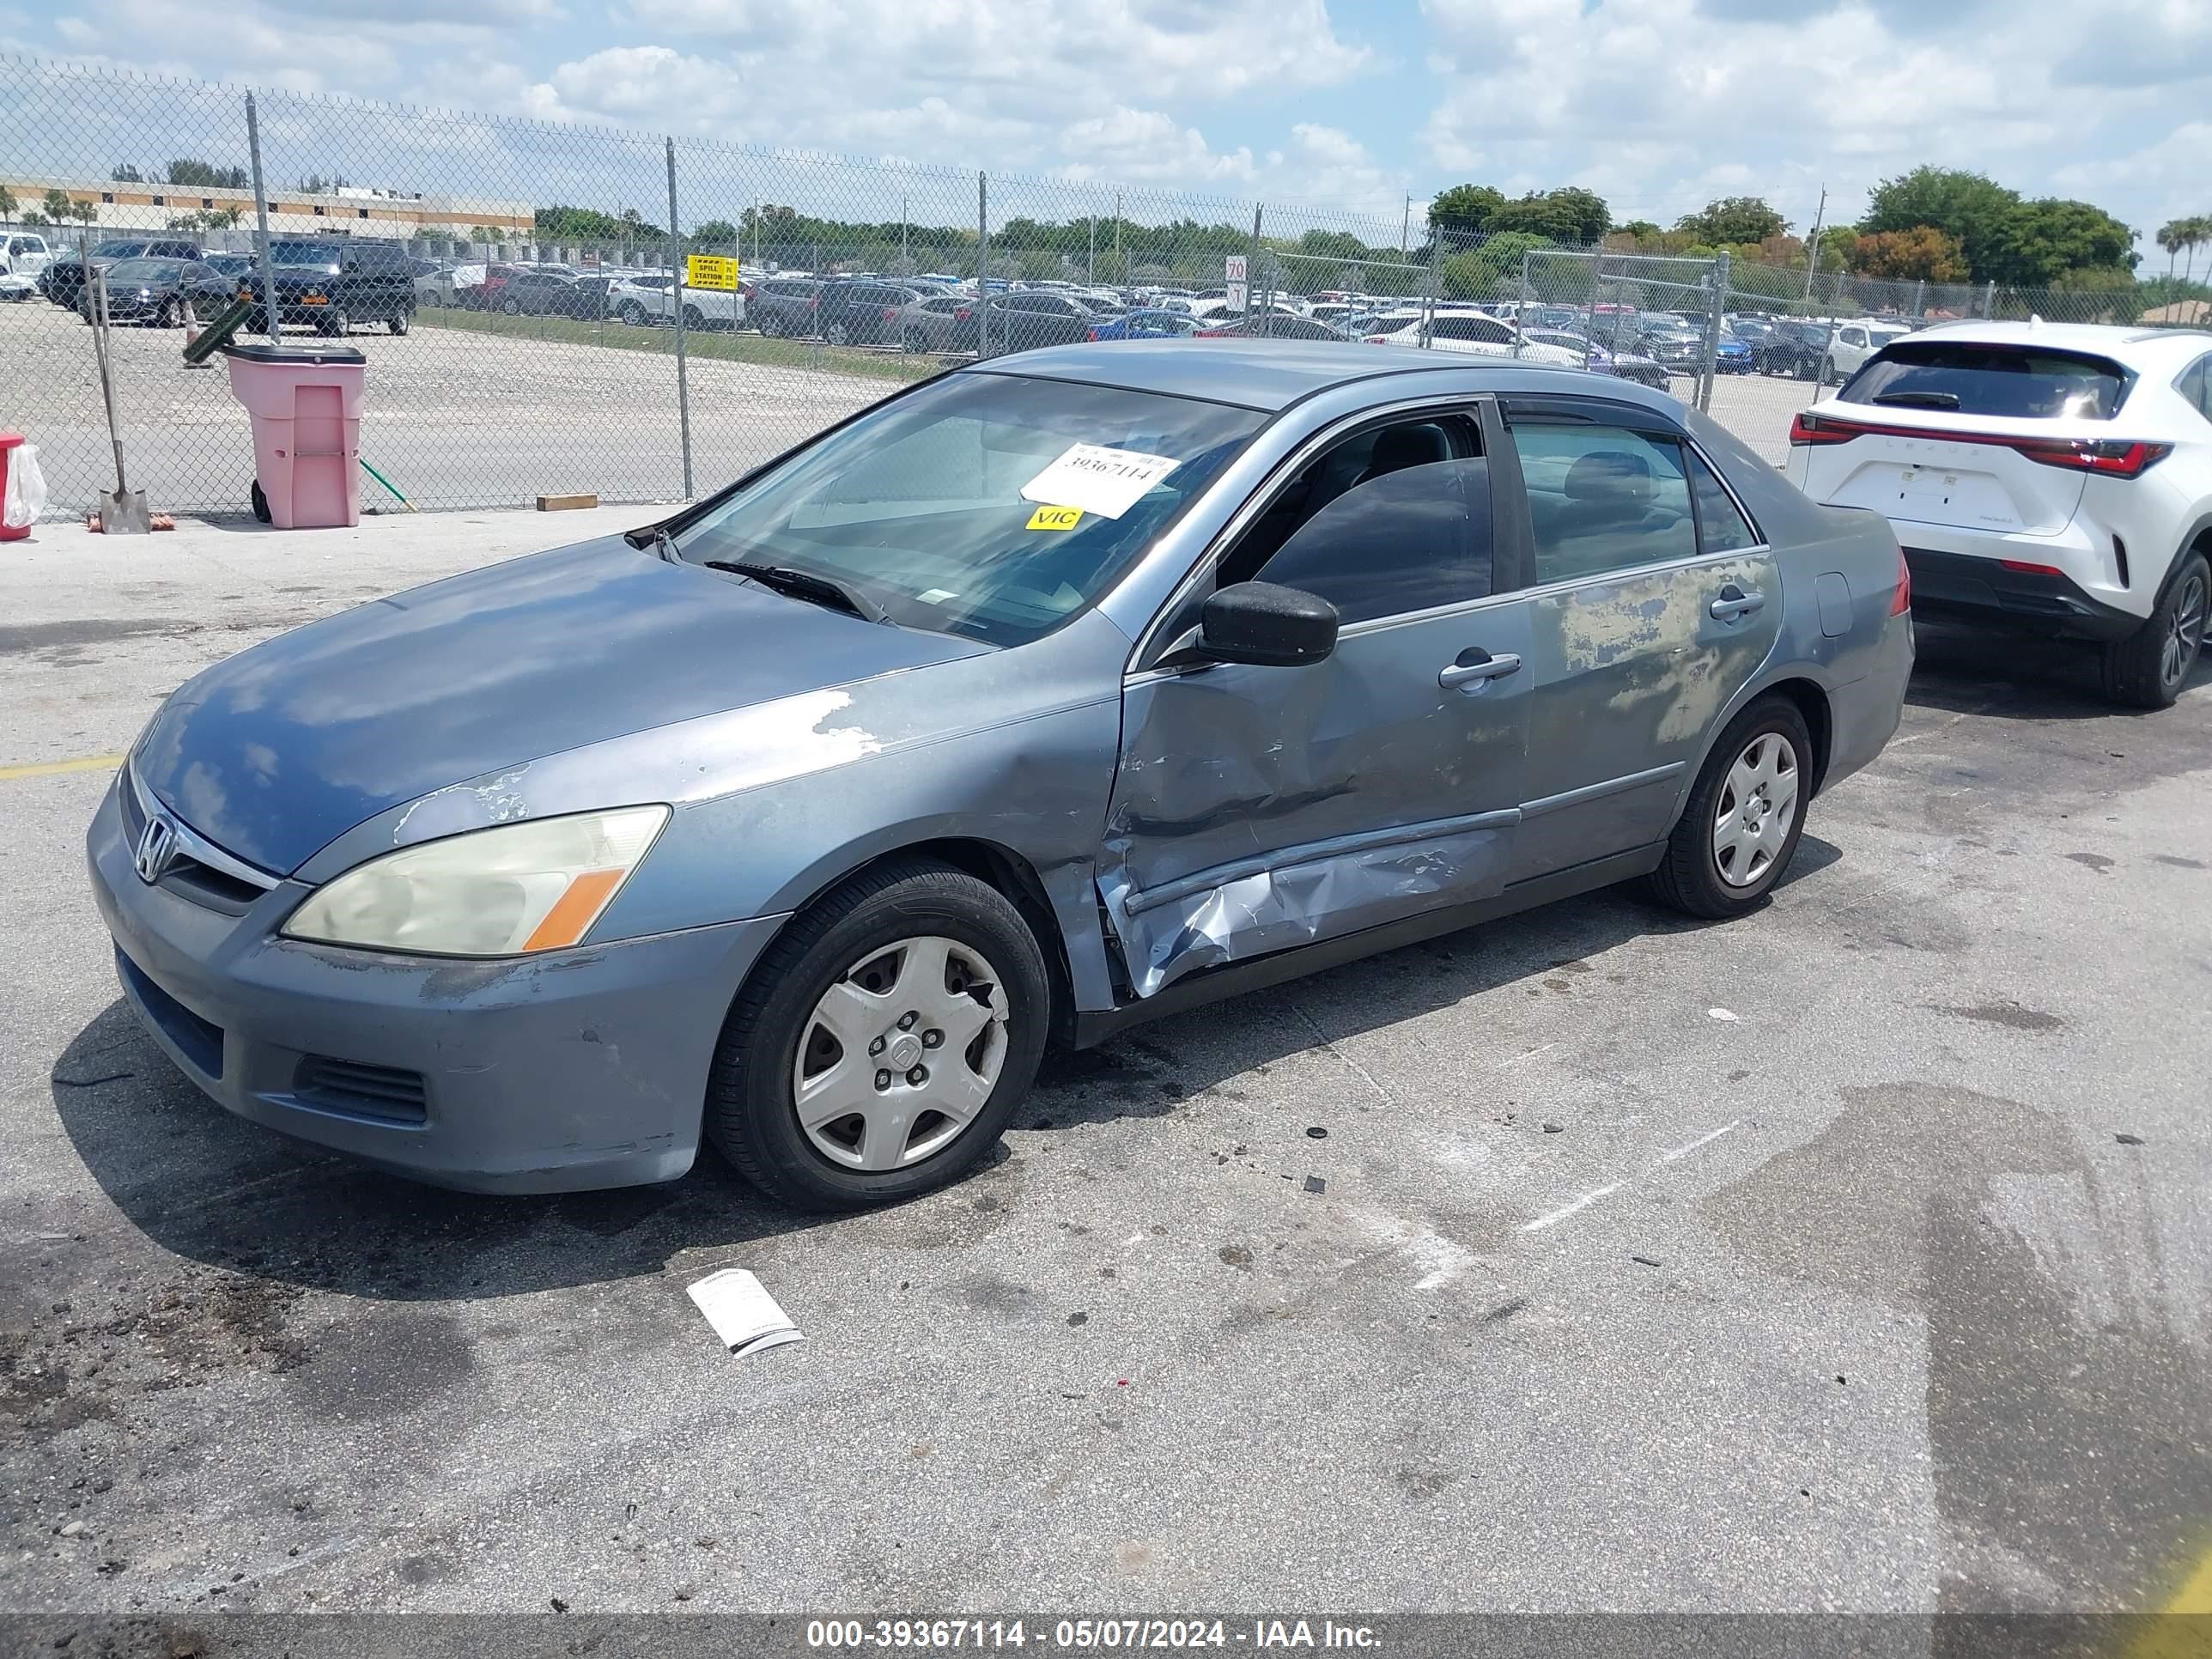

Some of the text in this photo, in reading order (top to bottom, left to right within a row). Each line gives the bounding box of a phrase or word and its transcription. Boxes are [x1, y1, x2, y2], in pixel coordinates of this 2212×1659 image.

[1229, 262, 1243, 277] 70
[1065, 457, 1152, 480] 39367114
[1037, 512, 1077, 524] VIC
